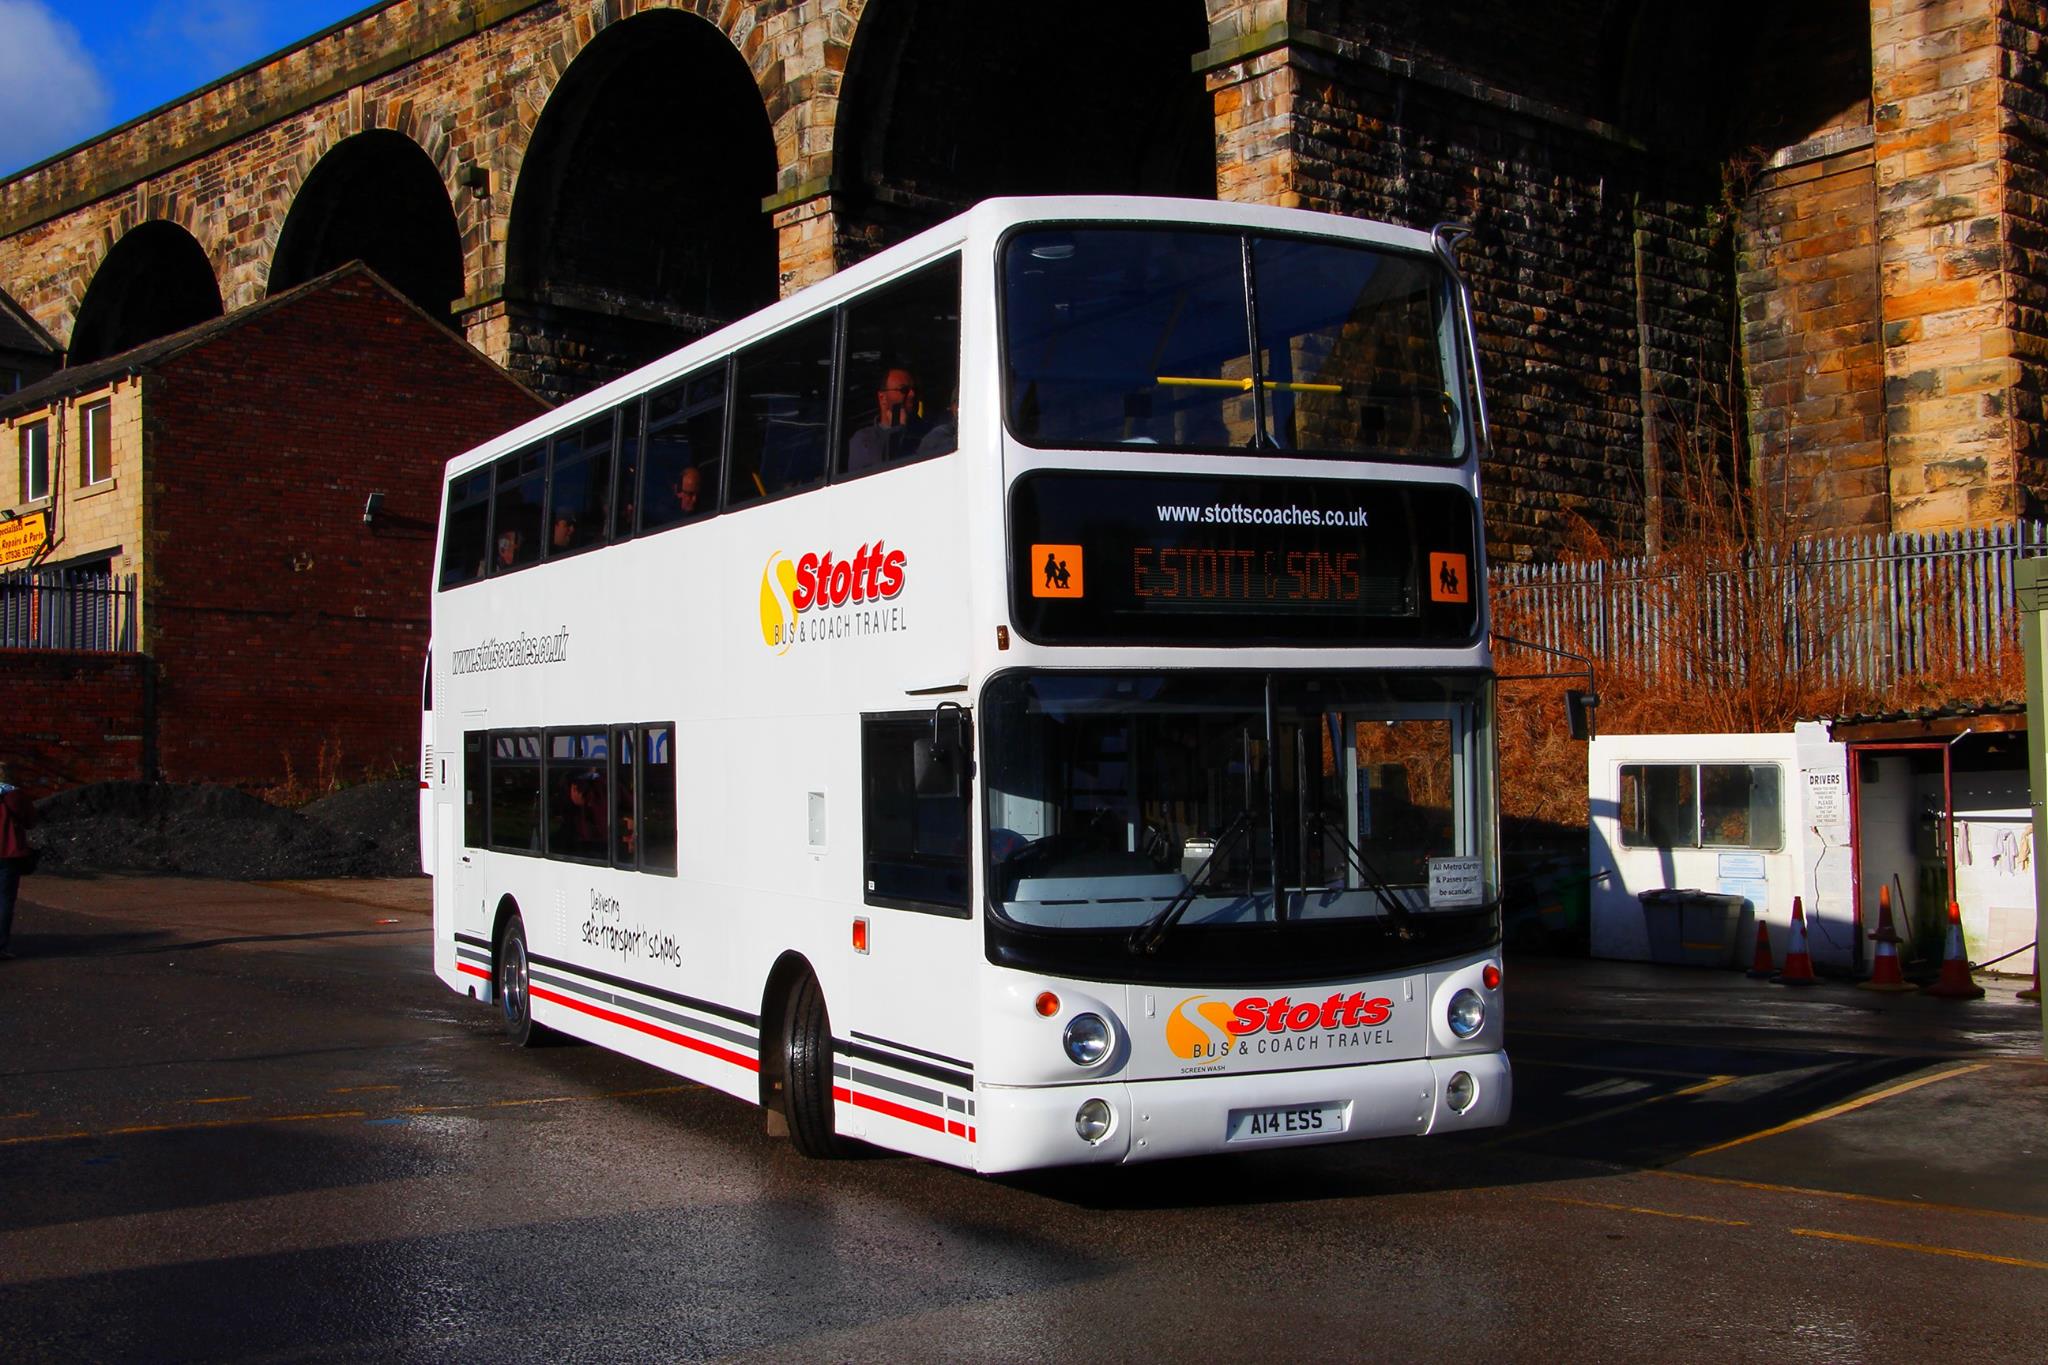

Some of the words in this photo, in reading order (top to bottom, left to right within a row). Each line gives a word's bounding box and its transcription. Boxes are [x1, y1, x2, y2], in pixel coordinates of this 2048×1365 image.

[1156, 503, 1369, 527] www.stottscoaches.co.uk
[29, 531, 44, 543] Parts
[792, 538, 907, 614] Stotts
[1287, 551, 1360, 600] SONS
[773, 621, 796, 646] BUS
[799, 620, 807, 643] &
[810, 614, 851, 642] COACH
[855, 606, 908, 637] TRAVEL
[451, 624, 570, 676] www.stottscoaches.co.uk
[1809, 774, 1840, 785] DRIVERS
[590, 887, 621, 923] Delivering
[600, 916, 642, 964] transport
[648, 928, 682, 968] schools
[1225, 990, 1395, 1037] Stotts
[1192, 1041, 1230, 1059] BUS
[1238, 1040, 1249, 1055] &
[1257, 1034, 1319, 1055] COACH
[1326, 1029, 1394, 1049] TRAVEL
[1180, 1066, 1206, 1074] SCREEN
[1250, 1113, 1280, 1135] A14
[1285, 1109, 1323, 1132] ESS
